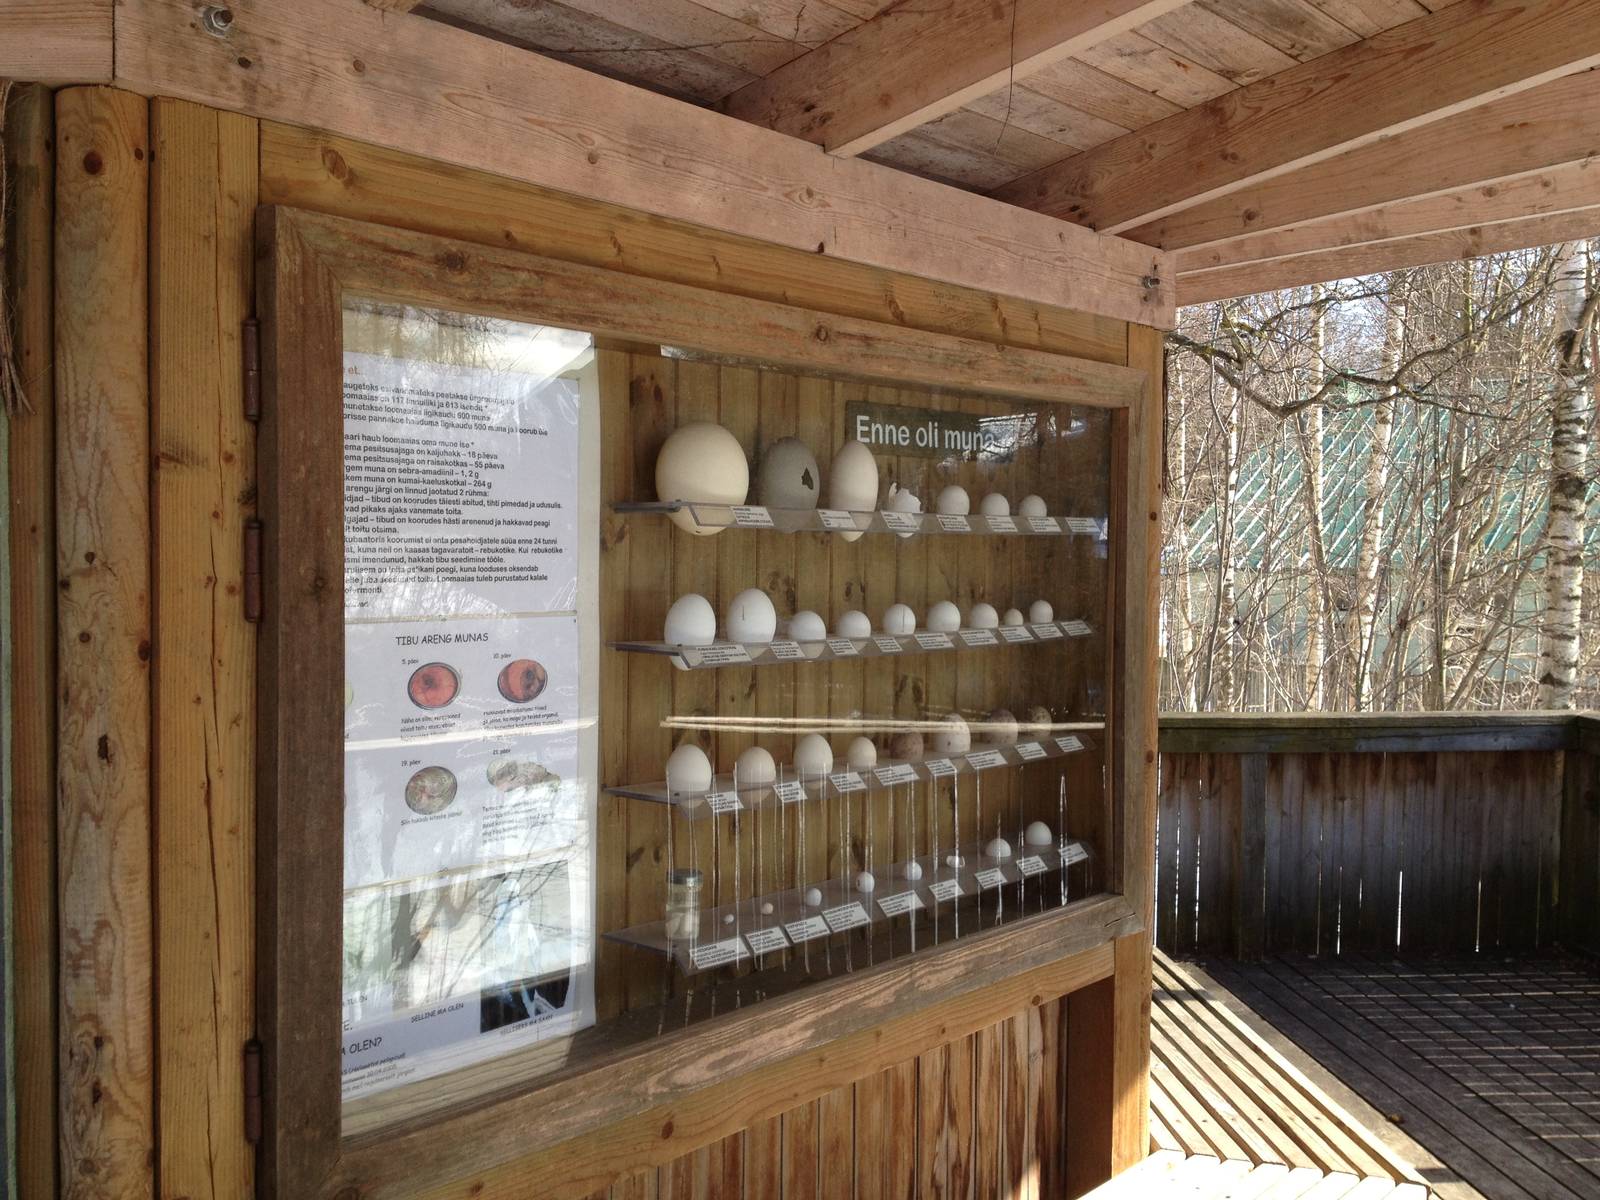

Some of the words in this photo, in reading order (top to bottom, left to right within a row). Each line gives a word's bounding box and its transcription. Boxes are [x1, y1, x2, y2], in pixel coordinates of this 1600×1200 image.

[445, 400, 458, 408] 613
[856, 415, 910, 446] Enne
[915, 421, 938, 448] oli
[361, 434, 381, 442] haub
[363, 444, 414, 456] pesitsusajaga
[427, 447, 461, 458] kaljuhakk
[363, 455, 414, 466] pesitsusajaga
[427, 458, 468, 467] raisakotkas
[474, 460, 483, 468] 55
[484, 461, 505, 470] päeva
[398, 466, 454, 476] sebra-amadiinil
[468, 469, 473, 477] 2
[473, 479, 486, 487] 264
[345, 486, 374, 494] arengu
[375, 485, 393, 495] järgi
[404, 486, 428, 494] linnud
[428, 487, 458, 496] jaotatud
[371, 495, 391, 503] tibud
[403, 496, 437, 504] koorudes
[438, 497, 461, 505] täiesti
[461, 498, 486, 508] abitud,
[500, 499, 529, 509] pimedad
[529, 500, 536, 510] ja
[361, 505, 386, 514] pikaks
[387, 505, 408, 515] ajaks
[375, 515, 395, 523] tibud
[407, 516, 442, 524] koorudes
[442, 517, 460, 525] hästi
[461, 518, 494, 526] arenenud
[494, 518, 502, 528] ja
[502, 518, 533, 526] hakkavad
[533, 519, 551, 528] peagi
[352, 525, 370, 533] toitu
[371, 525, 400, 533] otsima.
[387, 535, 424, 543] koorumist
[450, 536, 500, 546] pesahoidjatele
[533, 536, 542, 544] 24
[357, 545, 377, 553] kuna
[378, 545, 392, 553] neil
[431, 546, 474, 555] tagavaratoit
[518, 546, 529, 554] Kui
[531, 546, 563, 554] rebukotike
[361, 556, 406, 565] imendunud,
[407, 555, 434, 563] hakkab
[435, 555, 450, 563] tibu
[450, 555, 486, 563] seedimine
[435, 565, 458, 575] poegi,
[508, 564, 539, 572] oksendab
[476, 574, 494, 582] tuleb
[494, 573, 529, 583] purustatud
[529, 573, 548, 581] kalale
[395, 636, 419, 646] TIBU
[421, 634, 452, 645] ARENG
[454, 632, 489, 643] MUNAS
[349, 1036, 383, 1054] OLEN?
